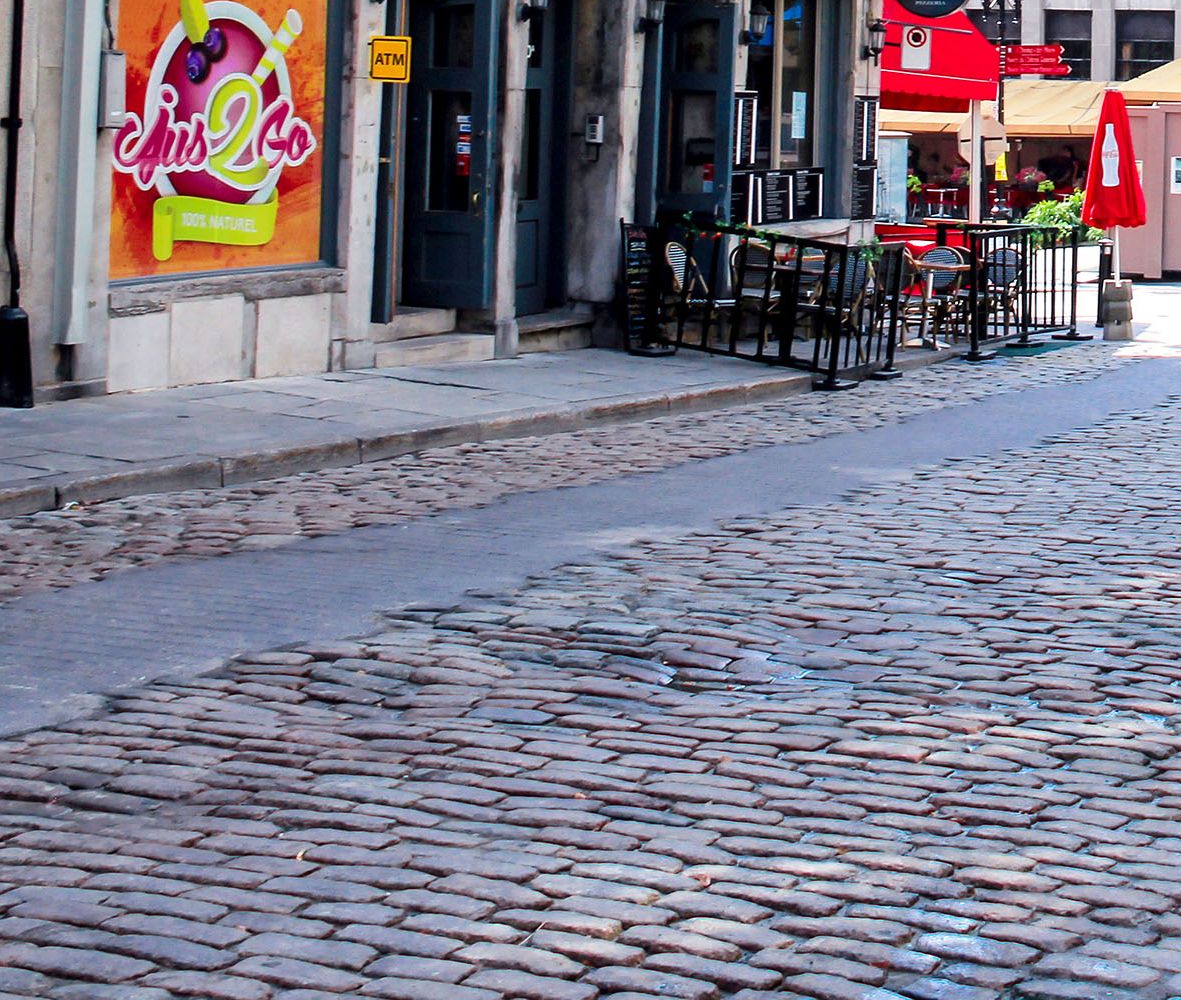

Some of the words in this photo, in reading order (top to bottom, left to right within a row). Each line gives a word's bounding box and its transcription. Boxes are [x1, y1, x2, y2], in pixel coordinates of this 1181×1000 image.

[374, 52, 405, 67] ATM
[182, 212, 207, 228] 100%
[209, 216, 257, 233] NATUREL
